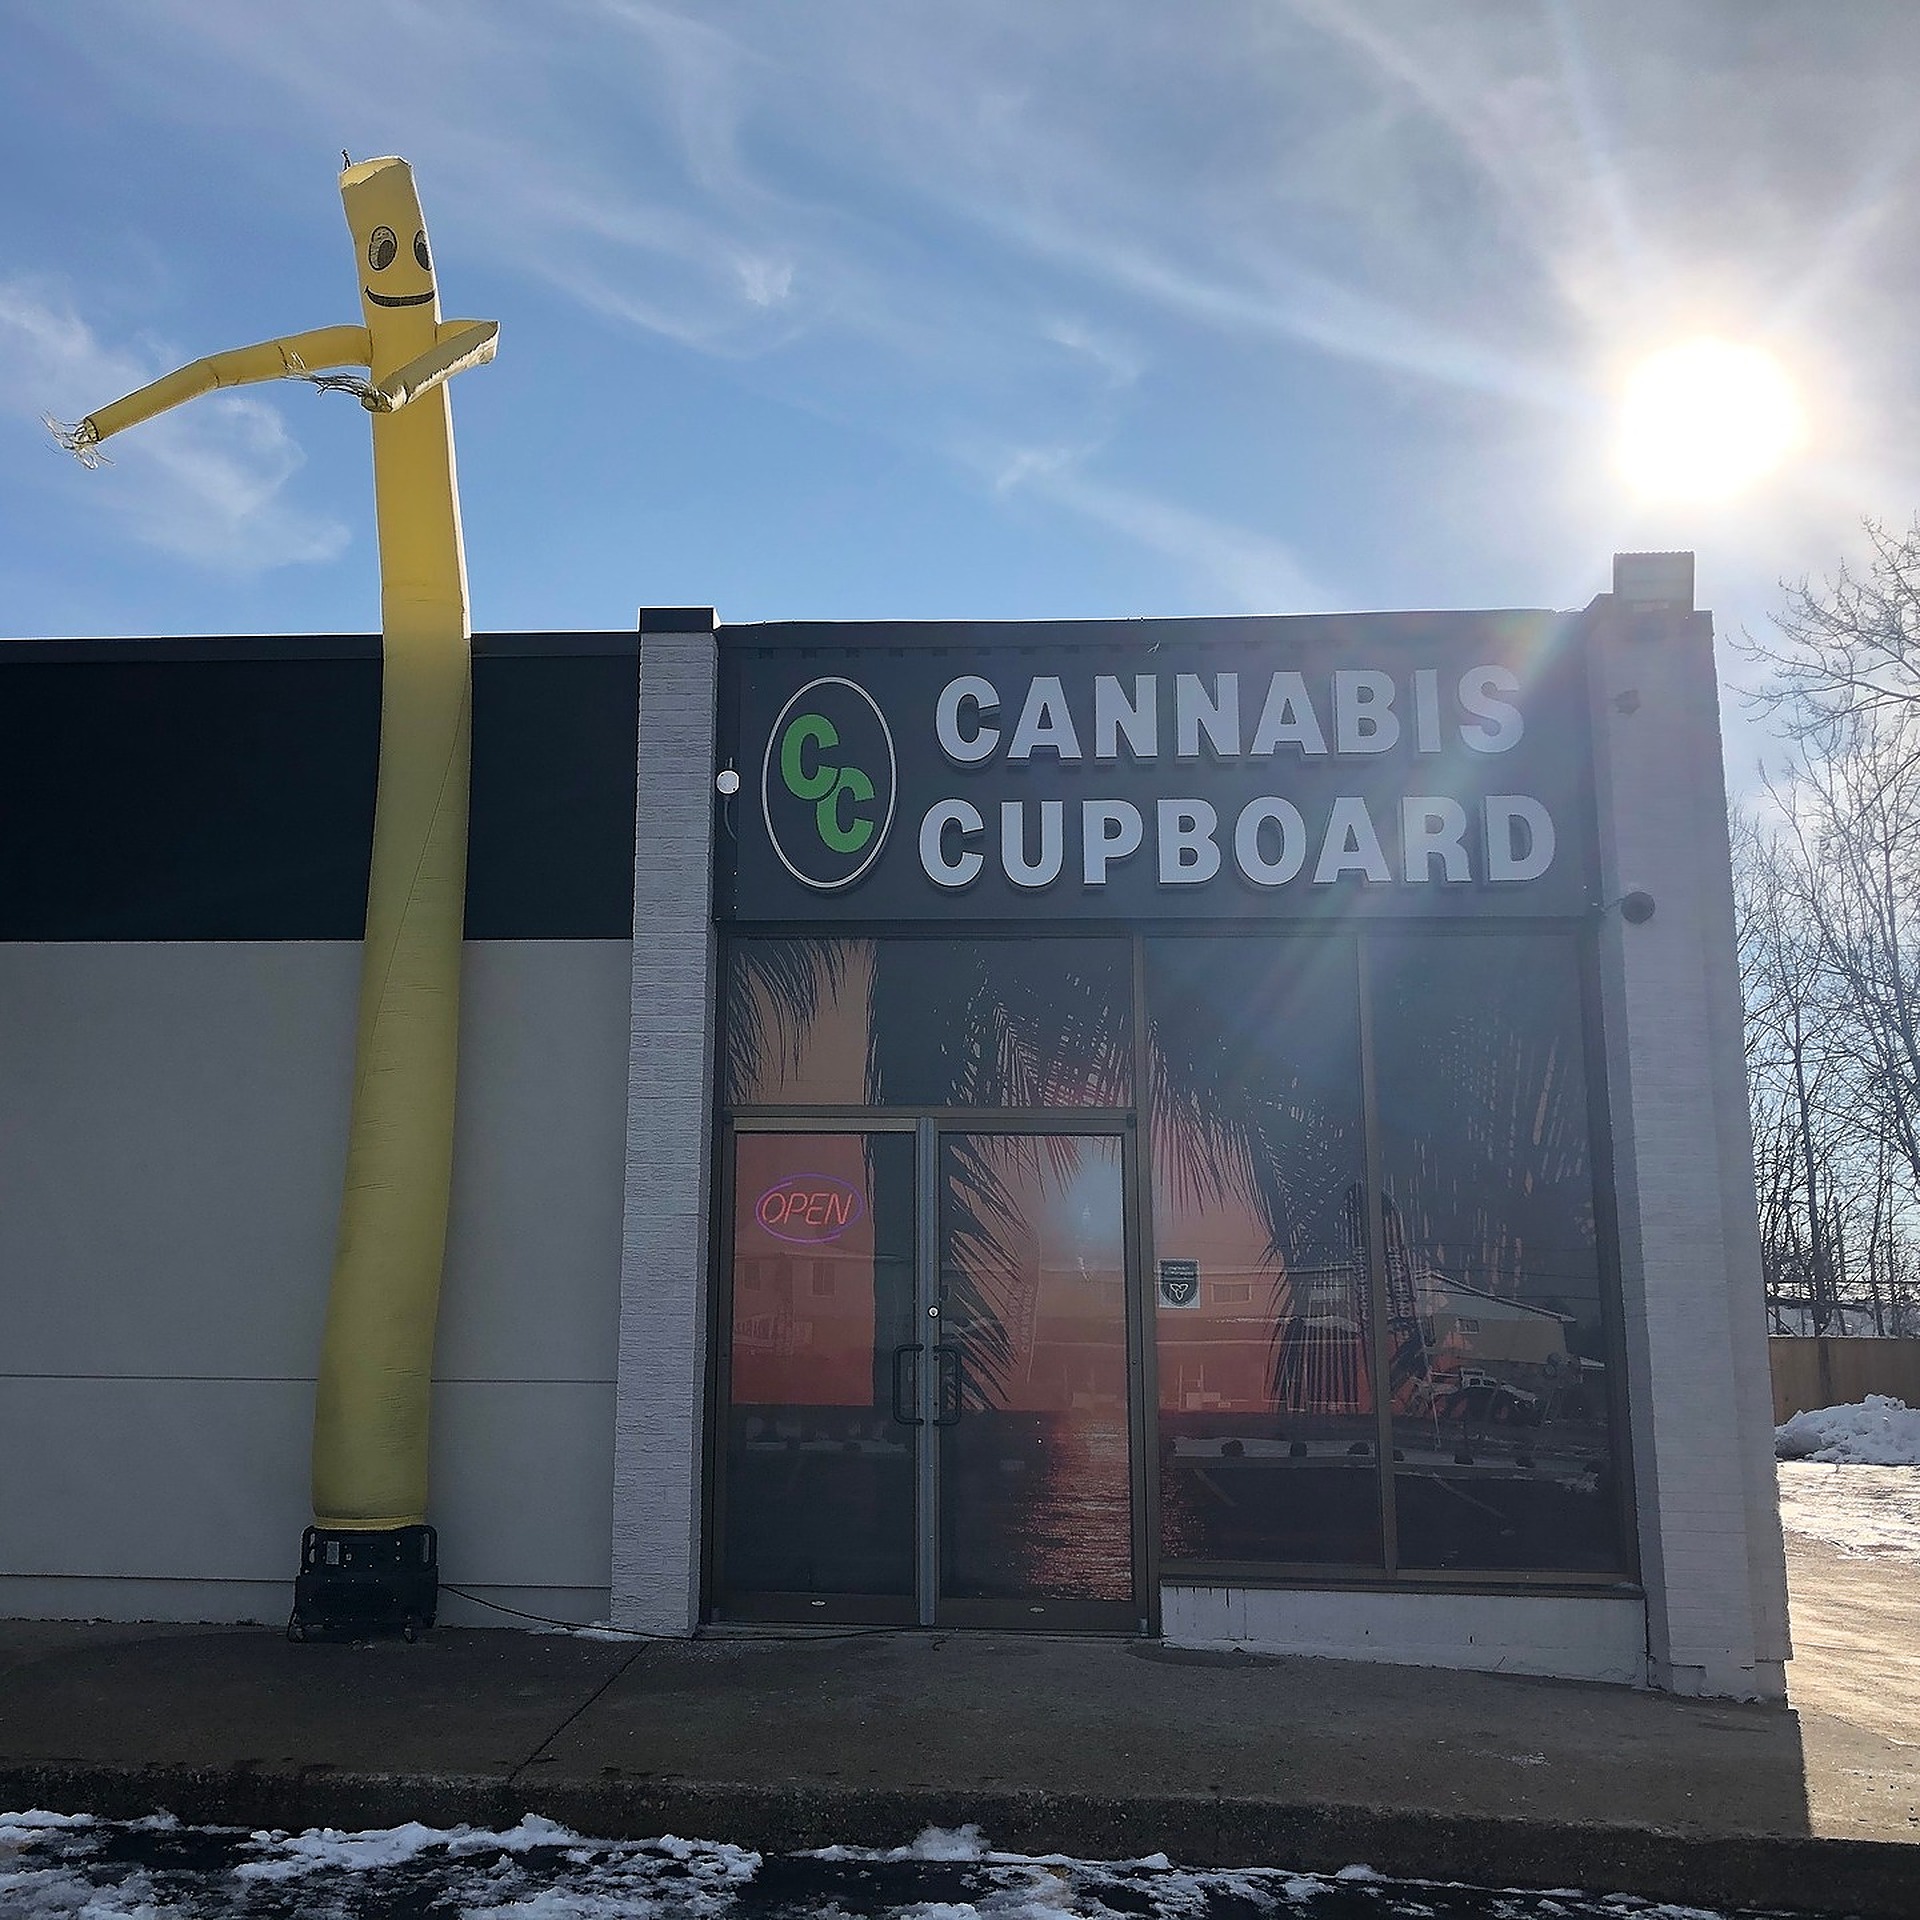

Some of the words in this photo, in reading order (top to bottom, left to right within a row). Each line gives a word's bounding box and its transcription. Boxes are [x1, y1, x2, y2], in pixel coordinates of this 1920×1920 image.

[935, 665, 1522, 761] CANNABIS
[919, 795, 1556, 887] CUPBOARD
[762, 1192, 852, 1225] OPEN
